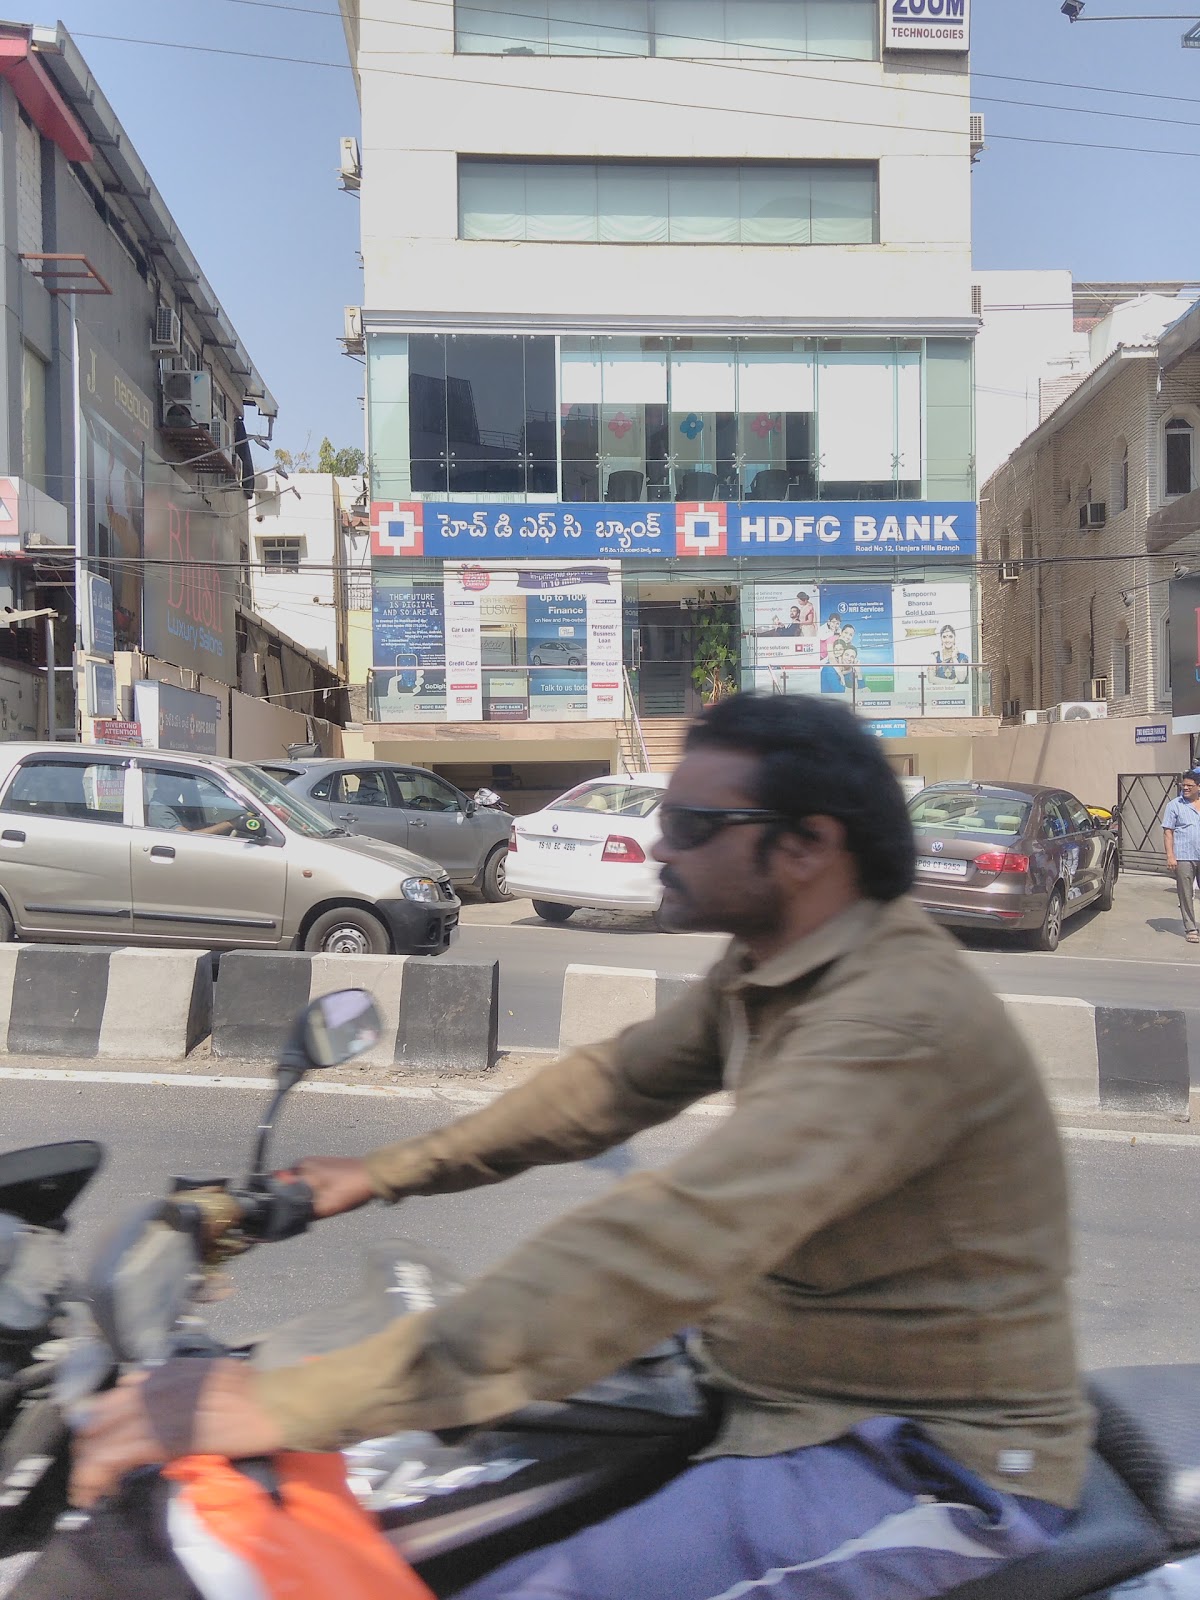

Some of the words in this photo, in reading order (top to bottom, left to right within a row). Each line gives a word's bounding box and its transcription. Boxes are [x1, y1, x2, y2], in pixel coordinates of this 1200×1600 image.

[892, 0, 964, 16] ZOOM
[891, 27, 964, 39] TECHNOLOGIES
[741, 515, 841, 542] HDFC
[854, 515, 960, 542] BANK
[884, 545, 895, 553] 12,
[936, 544, 960, 553] Branch
[541, 581, 548, 589] in
[550, 579, 560, 588] 10
[540, 594, 553, 603] Up
[555, 594, 564, 602] to
[389, 601, 399, 609] IS
[401, 601, 436, 609] DIGITAL
[382, 608, 398, 616] AND
[400, 608, 410, 616] SO
[412, 608, 426, 616] ARE
[548, 606, 584, 614] Finance
[168, 608, 198, 651] Luxury
[541, 684, 555, 692] Talk
[556, 684, 563, 692] to
[104, 722, 137, 730] DIVERTING
[943, 862, 961, 871] 5252
